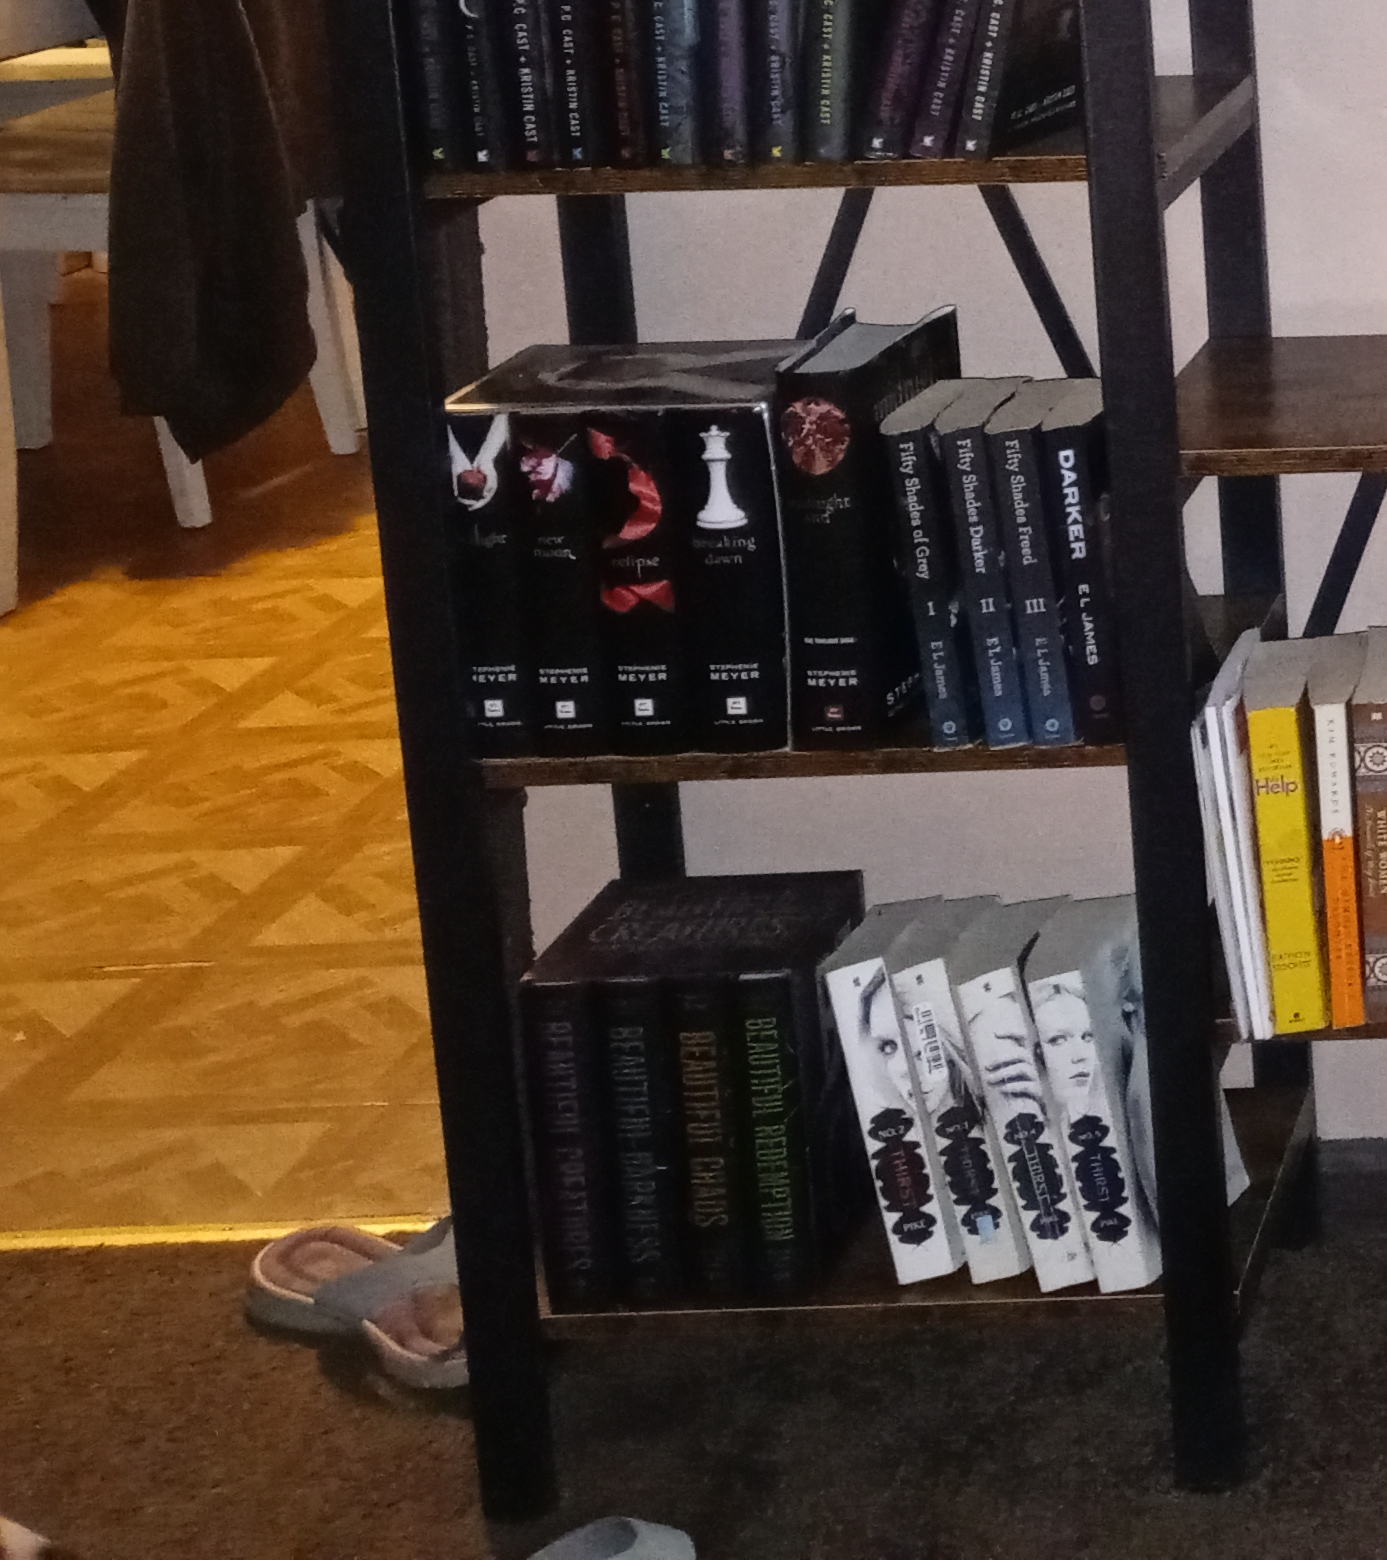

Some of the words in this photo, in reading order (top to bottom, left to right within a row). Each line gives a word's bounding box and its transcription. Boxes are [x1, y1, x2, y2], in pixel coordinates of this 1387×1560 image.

[899, 441, 914, 475] Fifty
[957, 439, 974, 472] Fifty
[1005, 439, 1022, 472] Fifty
[904, 477, 924, 526] Shades
[962, 474, 982, 523] Shades
[1010, 475, 1030, 524] Shades
[1058, 449, 1087, 560] DARKER
[913, 529, 929, 544] of
[970, 525, 988, 575] Darker
[1018, 526, 1038, 567] Freed
[916, 546, 930, 580] Grey
[807, 677, 859, 687] MEYER
[1255, 777, 1298, 797] Help
[745, 1017, 784, 1117] BEAUTIFUL
[690, 1157, 728, 1227] CHAOS
[754, 1124, 794, 1240] REDEMPTION
